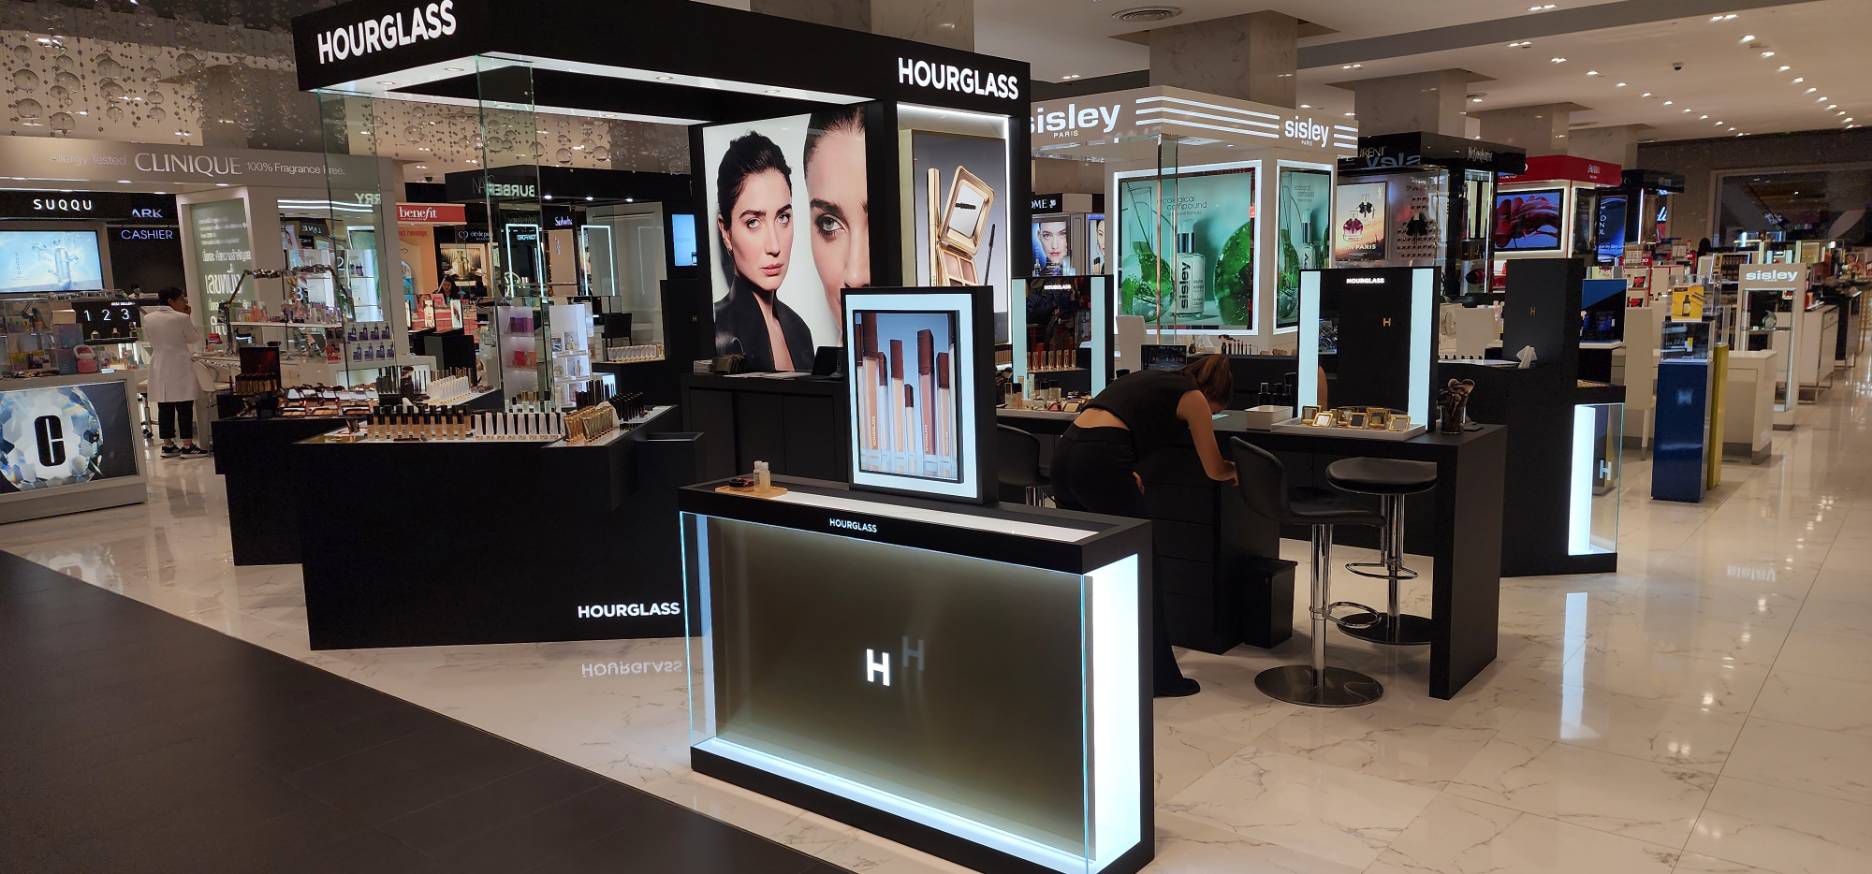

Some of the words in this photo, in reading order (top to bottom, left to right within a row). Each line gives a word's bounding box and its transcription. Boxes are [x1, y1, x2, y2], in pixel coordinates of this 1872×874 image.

[317, 0, 457, 64] HOURGLASS
[898, 57, 1019, 100] HOURGLASS
[1030, 103, 1121, 133] isley
[1053, 130, 1079, 138] PARIS
[1284, 115, 1329, 147] sisley
[135, 152, 243, 177] CLINIQUE
[247, 161, 273, 172] 100%
[274, 162, 321, 175] Fragrance
[33, 199, 93, 211] SUQQU
[399, 206, 437, 221] benefit
[121, 229, 173, 240] CASHIER
[1745, 270, 1798, 282] sisley
[1180, 262, 1191, 309] sisley
[83, 309, 91, 322] 1
[101, 308, 112, 321] 2
[120, 308, 131, 320] 3
[1382, 317, 1392, 328] H
[829, 517, 878, 534] HOURGLASS
[577, 601, 681, 620] HOURGLASS
[865, 648, 891, 687] H
